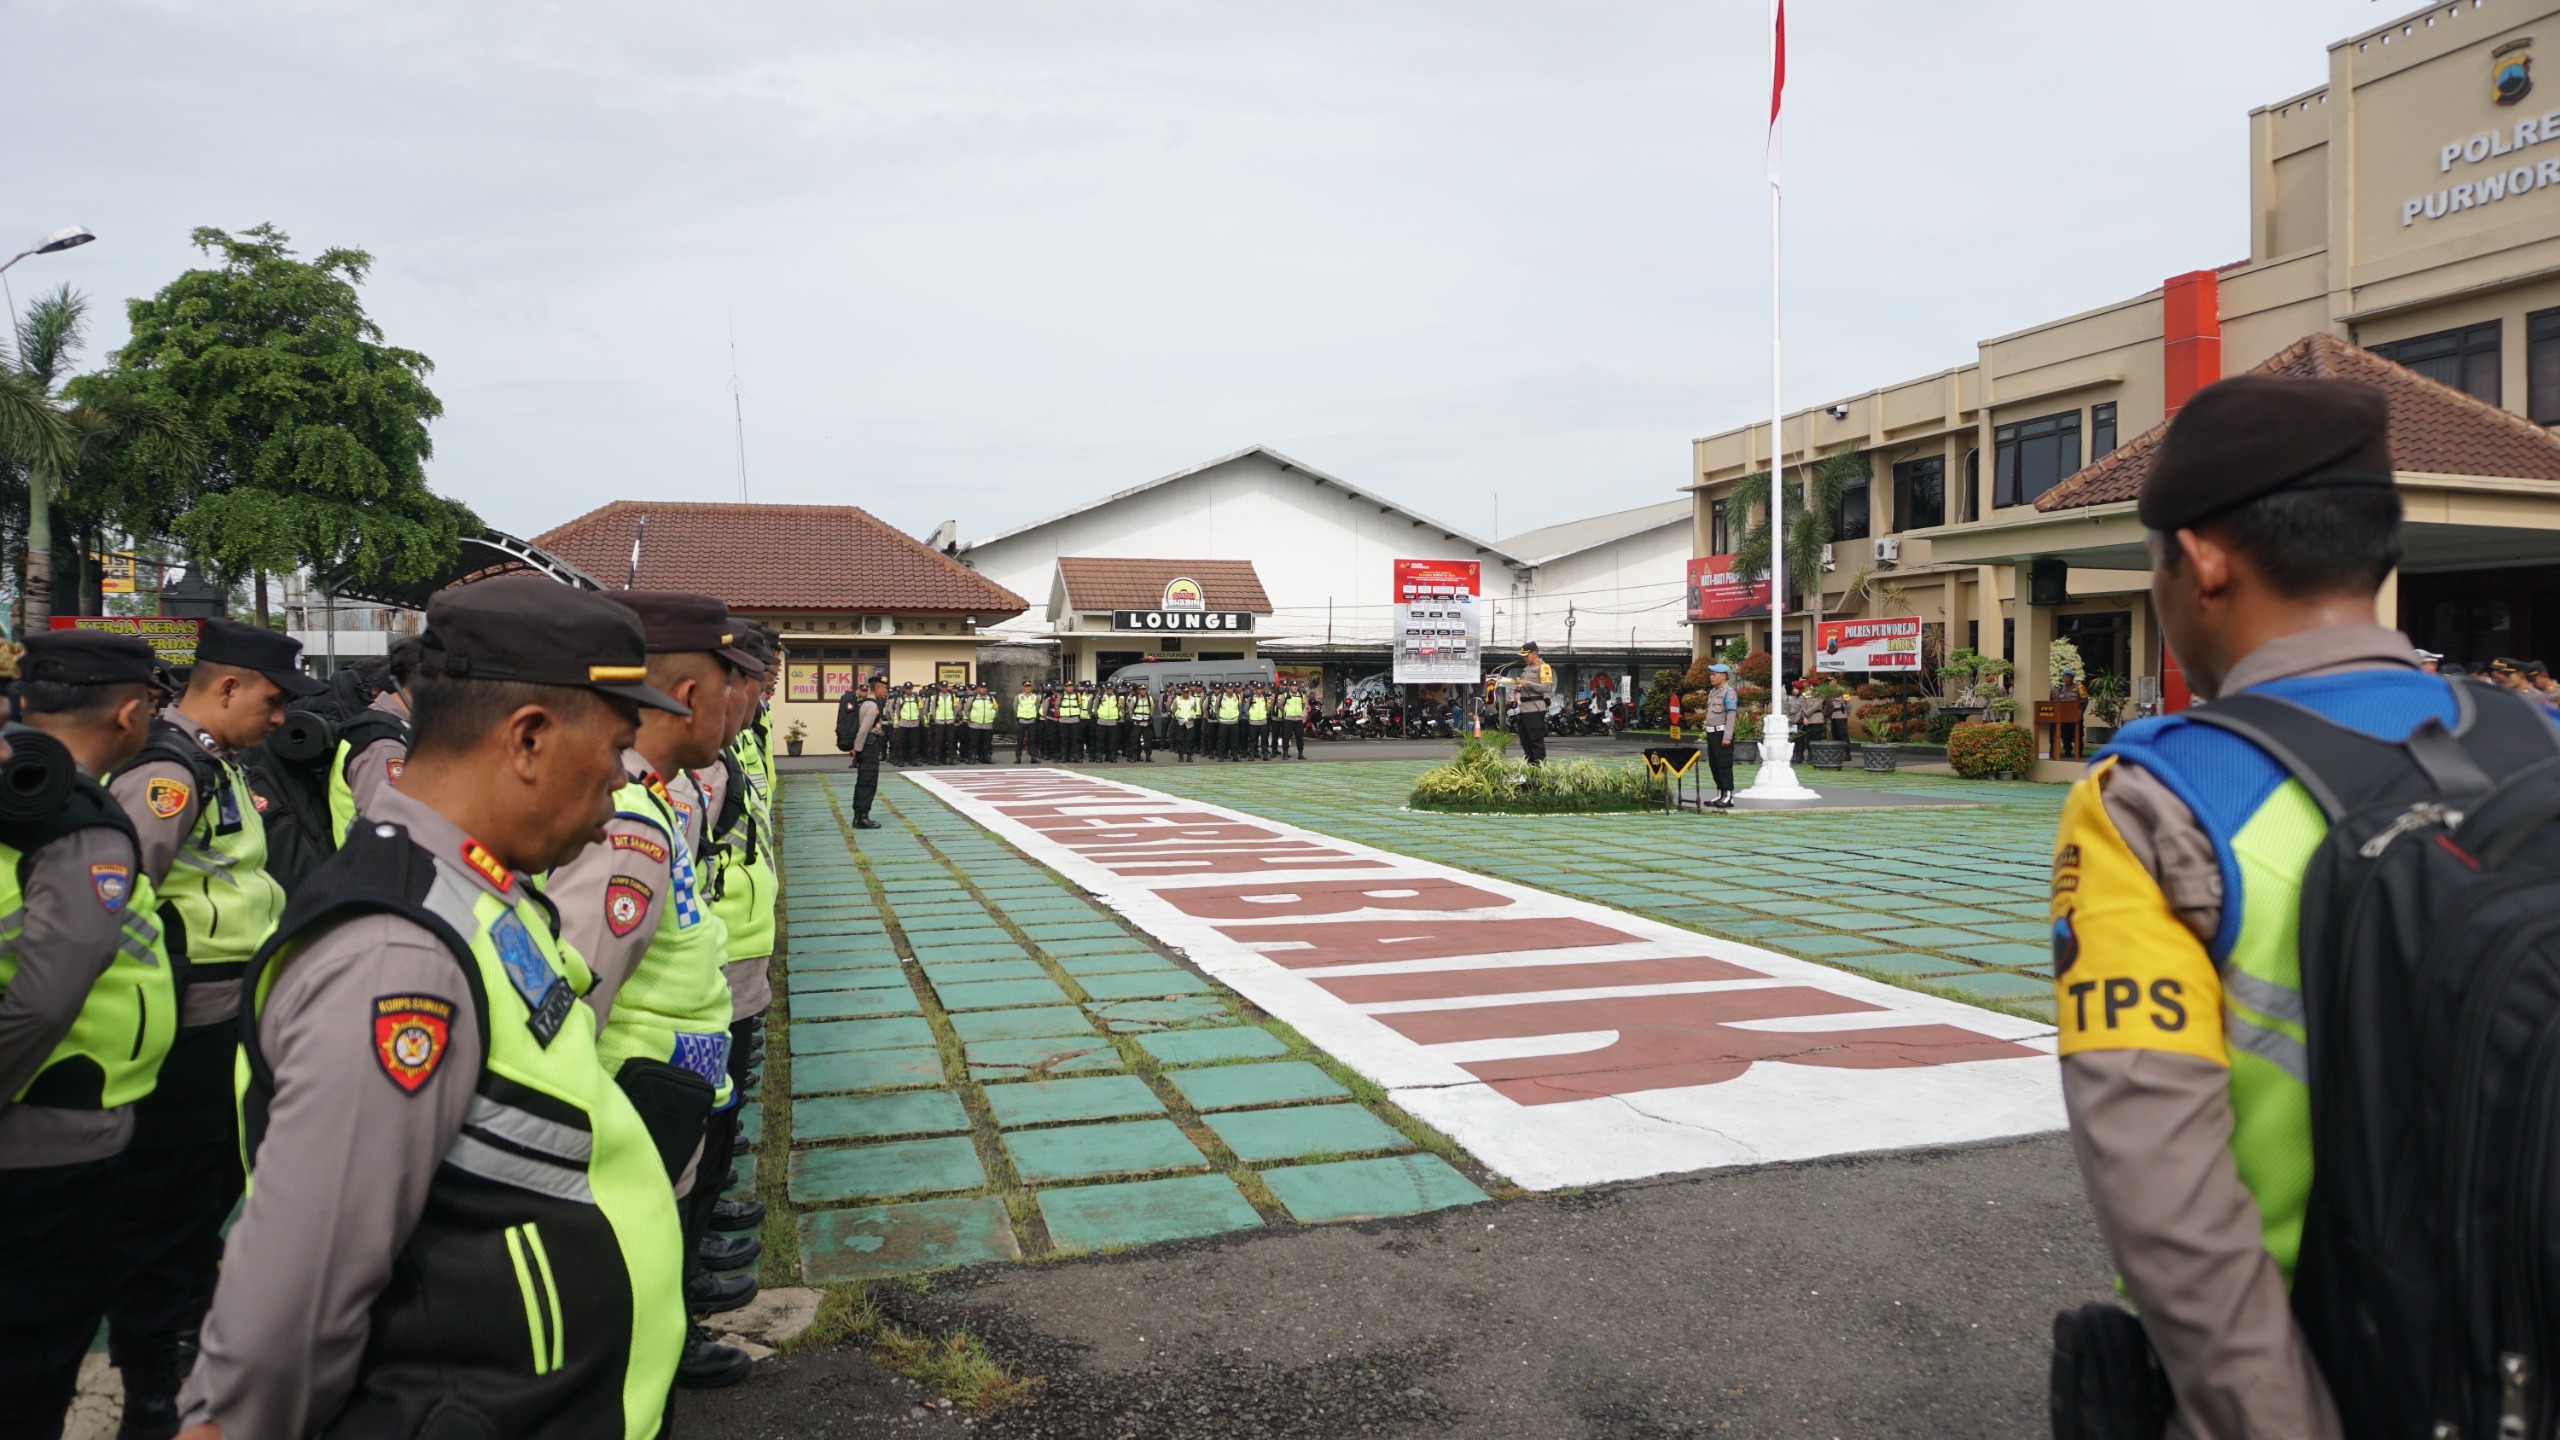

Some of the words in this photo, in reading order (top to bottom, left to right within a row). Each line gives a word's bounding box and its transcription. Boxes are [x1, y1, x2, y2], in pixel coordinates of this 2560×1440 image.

[141, 621, 198, 635] KERAS
[1130, 612, 1237, 629] LOUNGE
[1845, 625, 1870, 638] POLRES
[1872, 622, 1916, 637] PURWOREJO
[1888, 638, 1916, 651] HARUS
[614, 836, 629, 847] DIT
[991, 801, 1398, 877] LEBIH
[1150, 876, 2053, 1107] BAIK
[378, 997, 411, 1013] KORPS
[2068, 977, 2187, 1032] TPS
